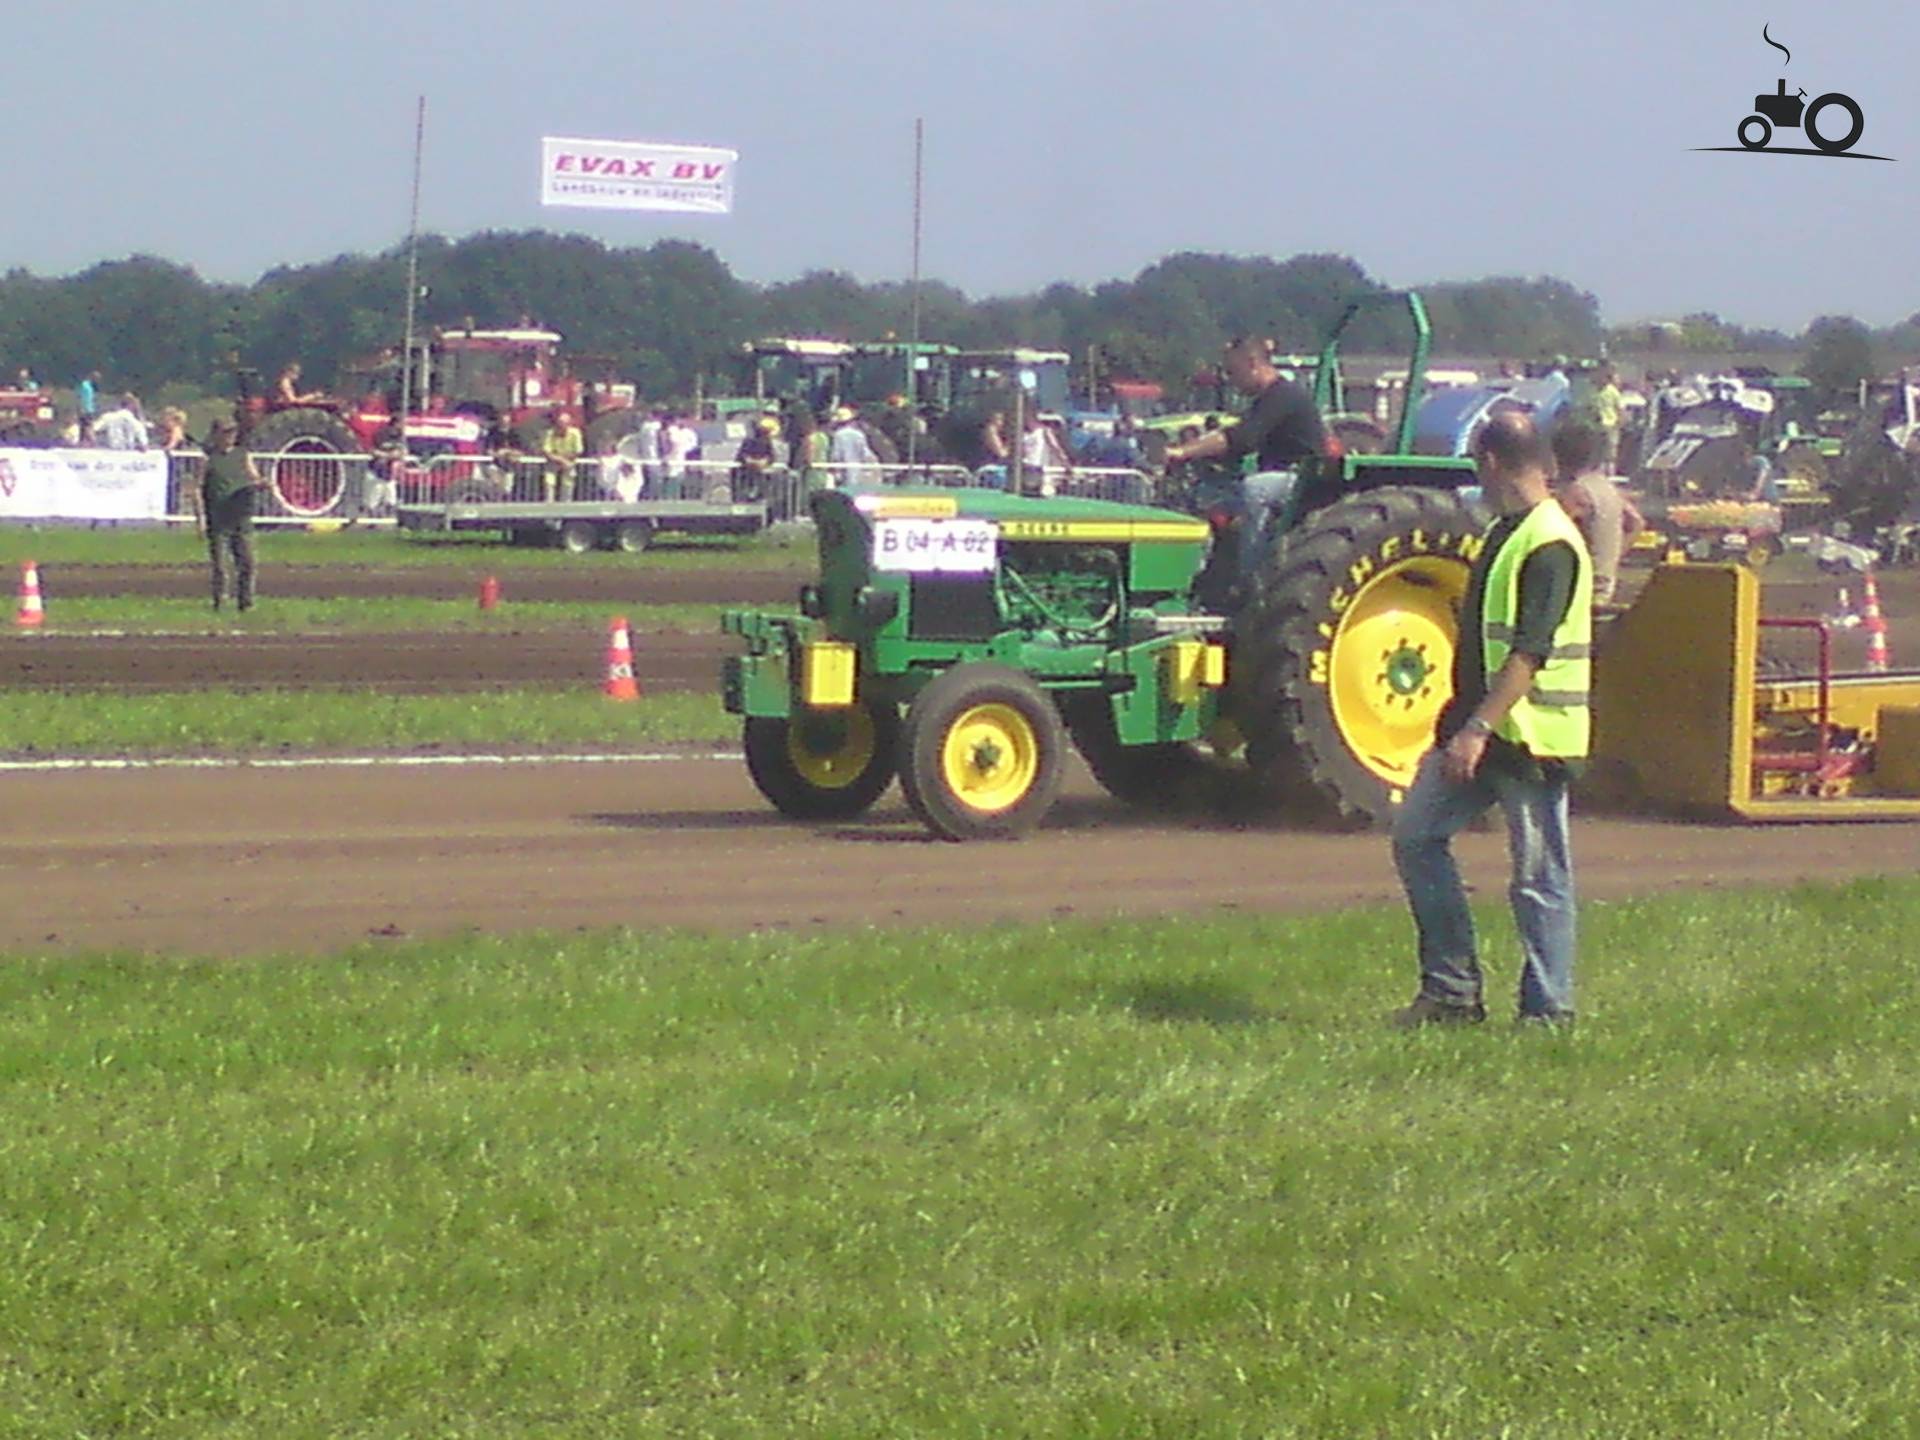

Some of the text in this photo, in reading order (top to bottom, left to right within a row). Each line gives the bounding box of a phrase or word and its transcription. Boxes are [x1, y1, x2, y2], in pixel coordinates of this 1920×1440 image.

[554, 154, 723, 181] EVAX BV
[883, 529, 898, 552] B
[1309, 528, 1484, 684] MICHELIN
